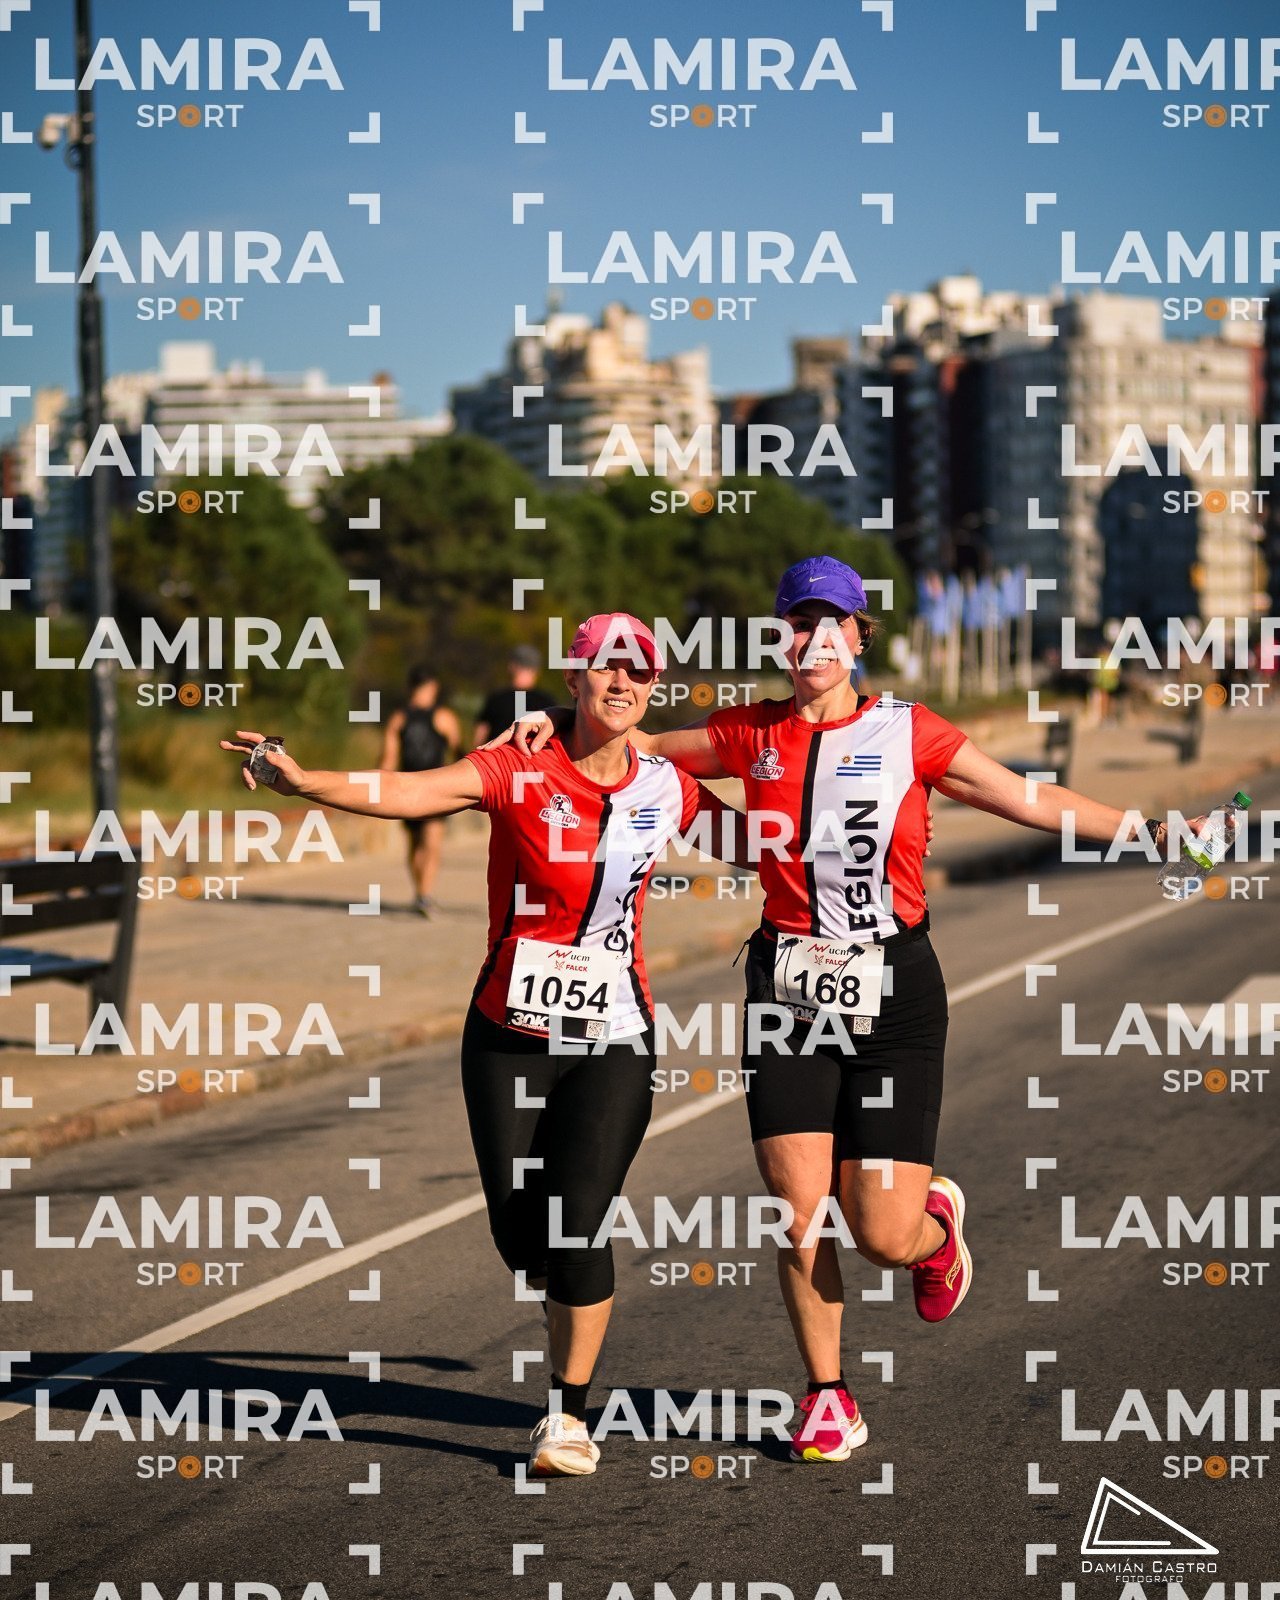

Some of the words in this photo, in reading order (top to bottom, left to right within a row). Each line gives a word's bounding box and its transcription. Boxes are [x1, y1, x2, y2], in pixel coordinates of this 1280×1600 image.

[828, 947, 850, 956] ucm
[570, 953, 592, 963] ucm
[565, 964, 588, 972] FALCK
[519, 972, 609, 1014] 1054
[793, 969, 861, 1008] 168
